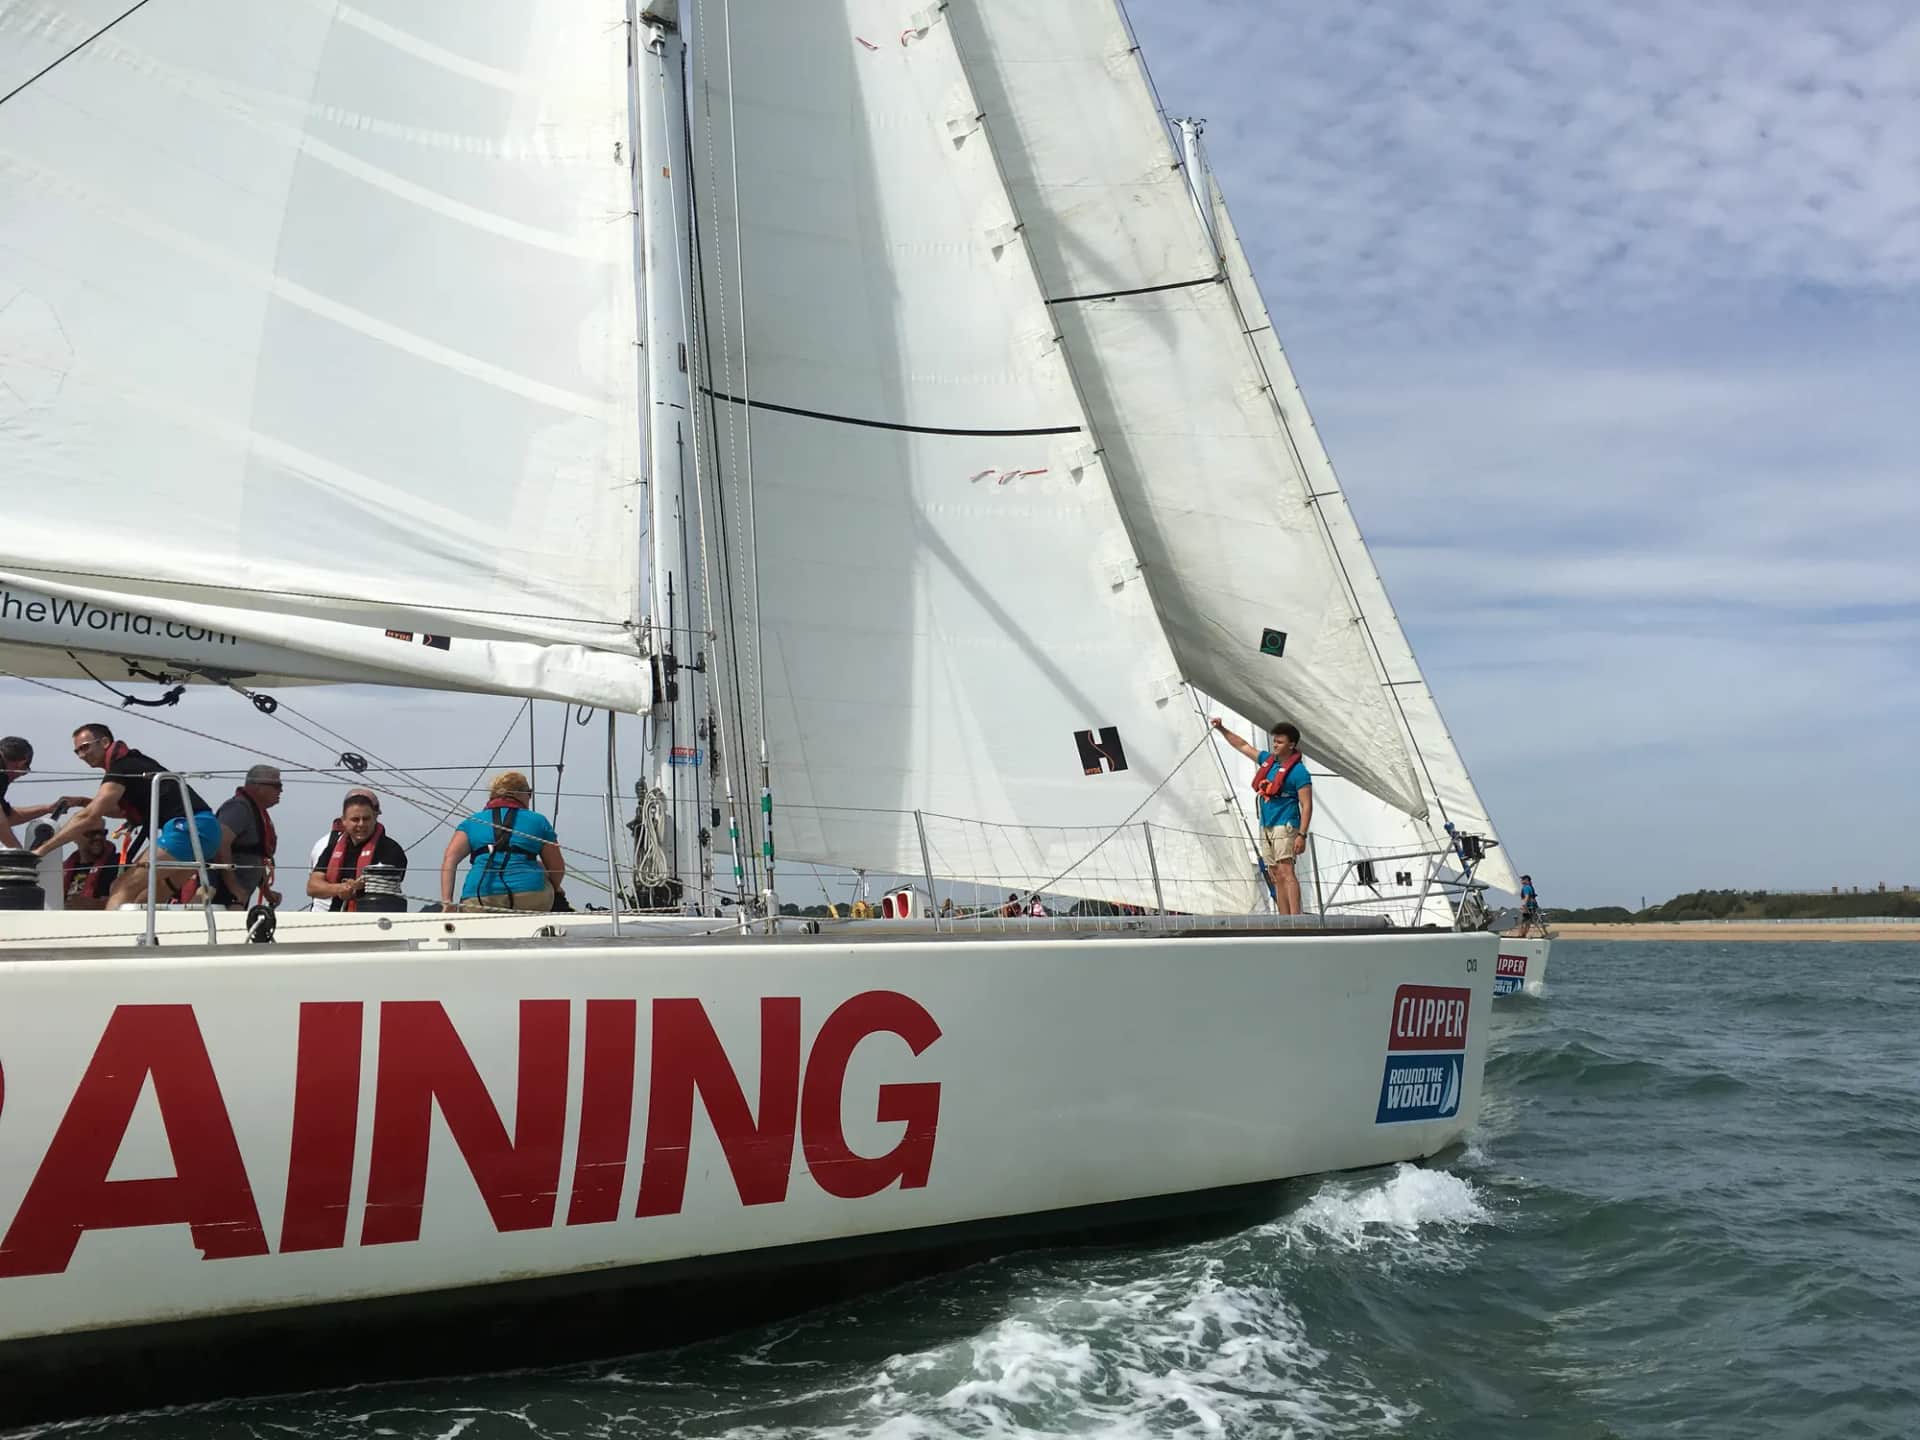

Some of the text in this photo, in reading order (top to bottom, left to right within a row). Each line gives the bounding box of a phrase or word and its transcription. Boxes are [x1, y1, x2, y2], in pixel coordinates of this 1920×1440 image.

[0, 590, 236, 646] heWorld.co
[1397, 997, 1465, 1038] CLIPPER
[1387, 1083, 1441, 1110] WORLD
[1389, 1067, 1444, 1085] ROUND THE
[0, 990, 943, 1278] AINING
